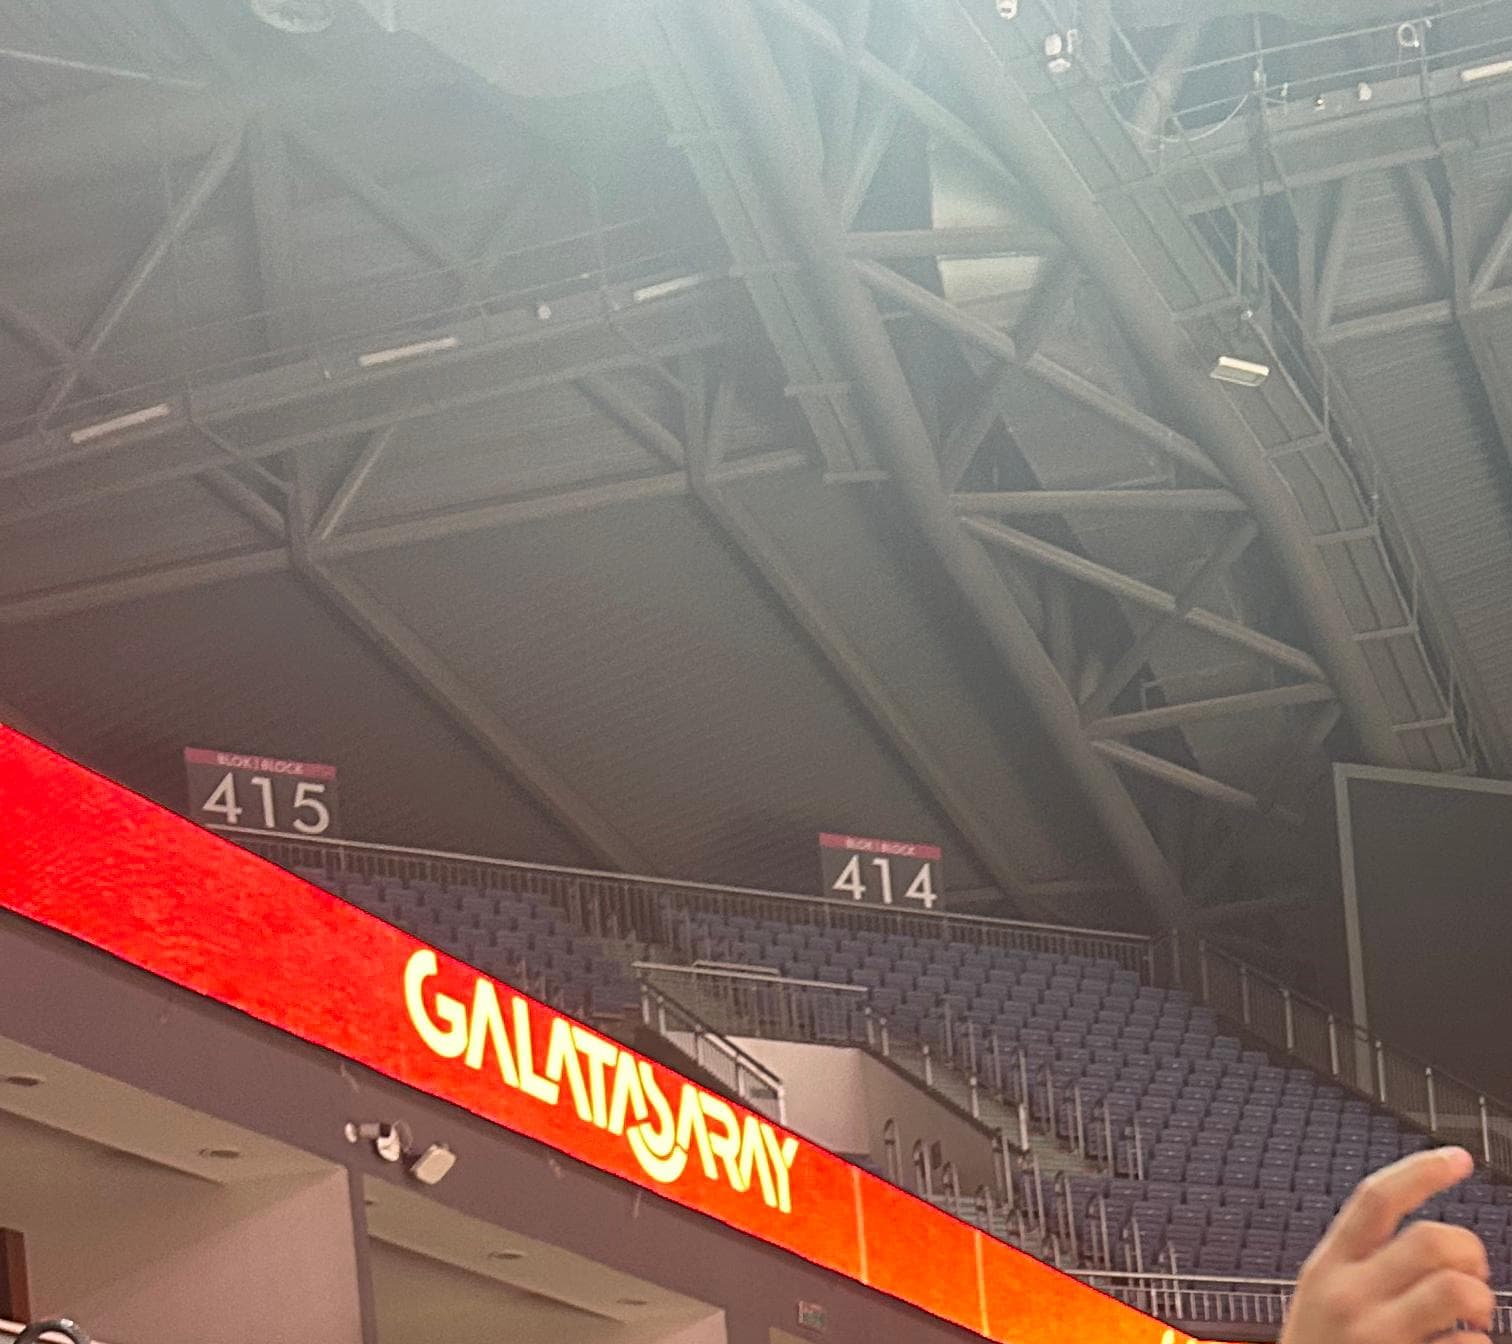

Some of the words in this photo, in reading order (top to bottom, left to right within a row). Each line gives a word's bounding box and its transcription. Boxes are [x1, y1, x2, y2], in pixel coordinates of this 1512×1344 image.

[202, 772, 331, 835] 415
[832, 854, 938, 908] 414
[404, 949, 800, 1214] GALATASARAY
